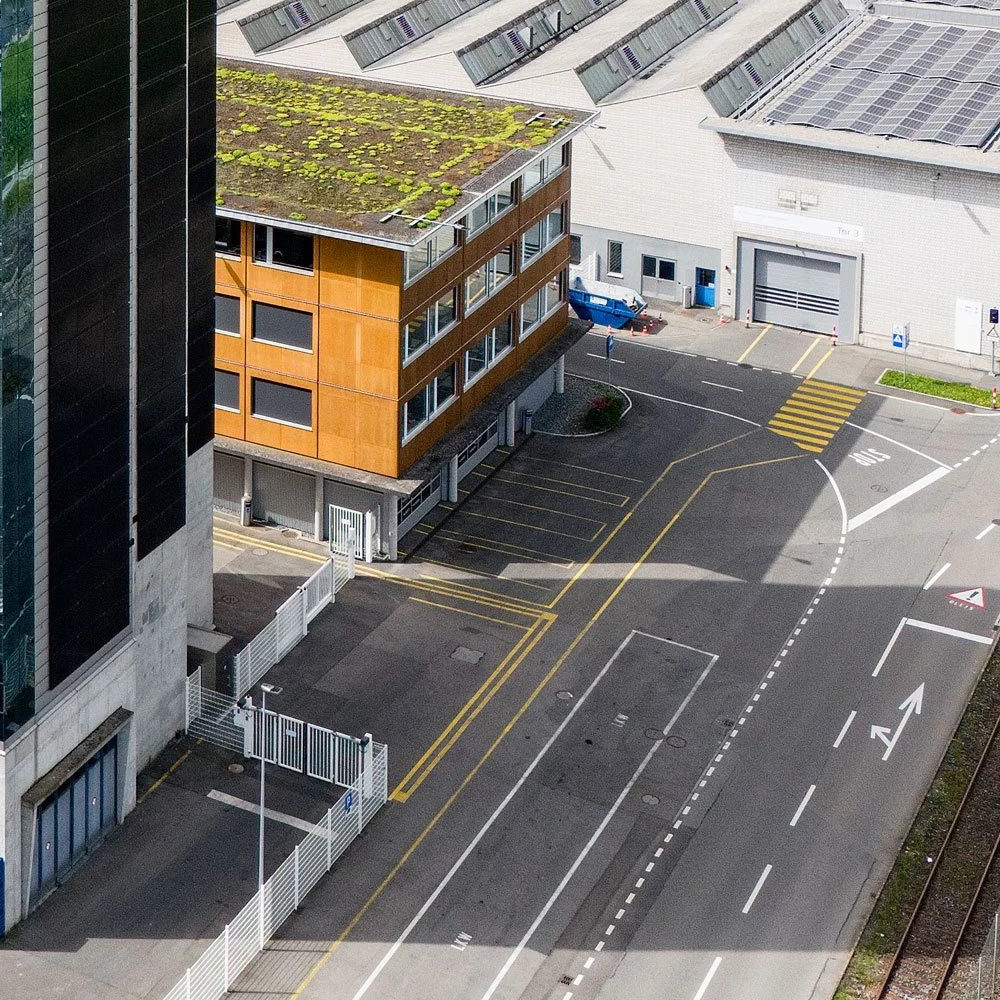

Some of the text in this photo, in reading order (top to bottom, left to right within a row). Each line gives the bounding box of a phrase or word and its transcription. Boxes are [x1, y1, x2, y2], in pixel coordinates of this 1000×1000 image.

[837, 226, 860, 238] Tor 3
[848, 448, 891, 467] STOP
[450, 931, 473, 951] LKW
